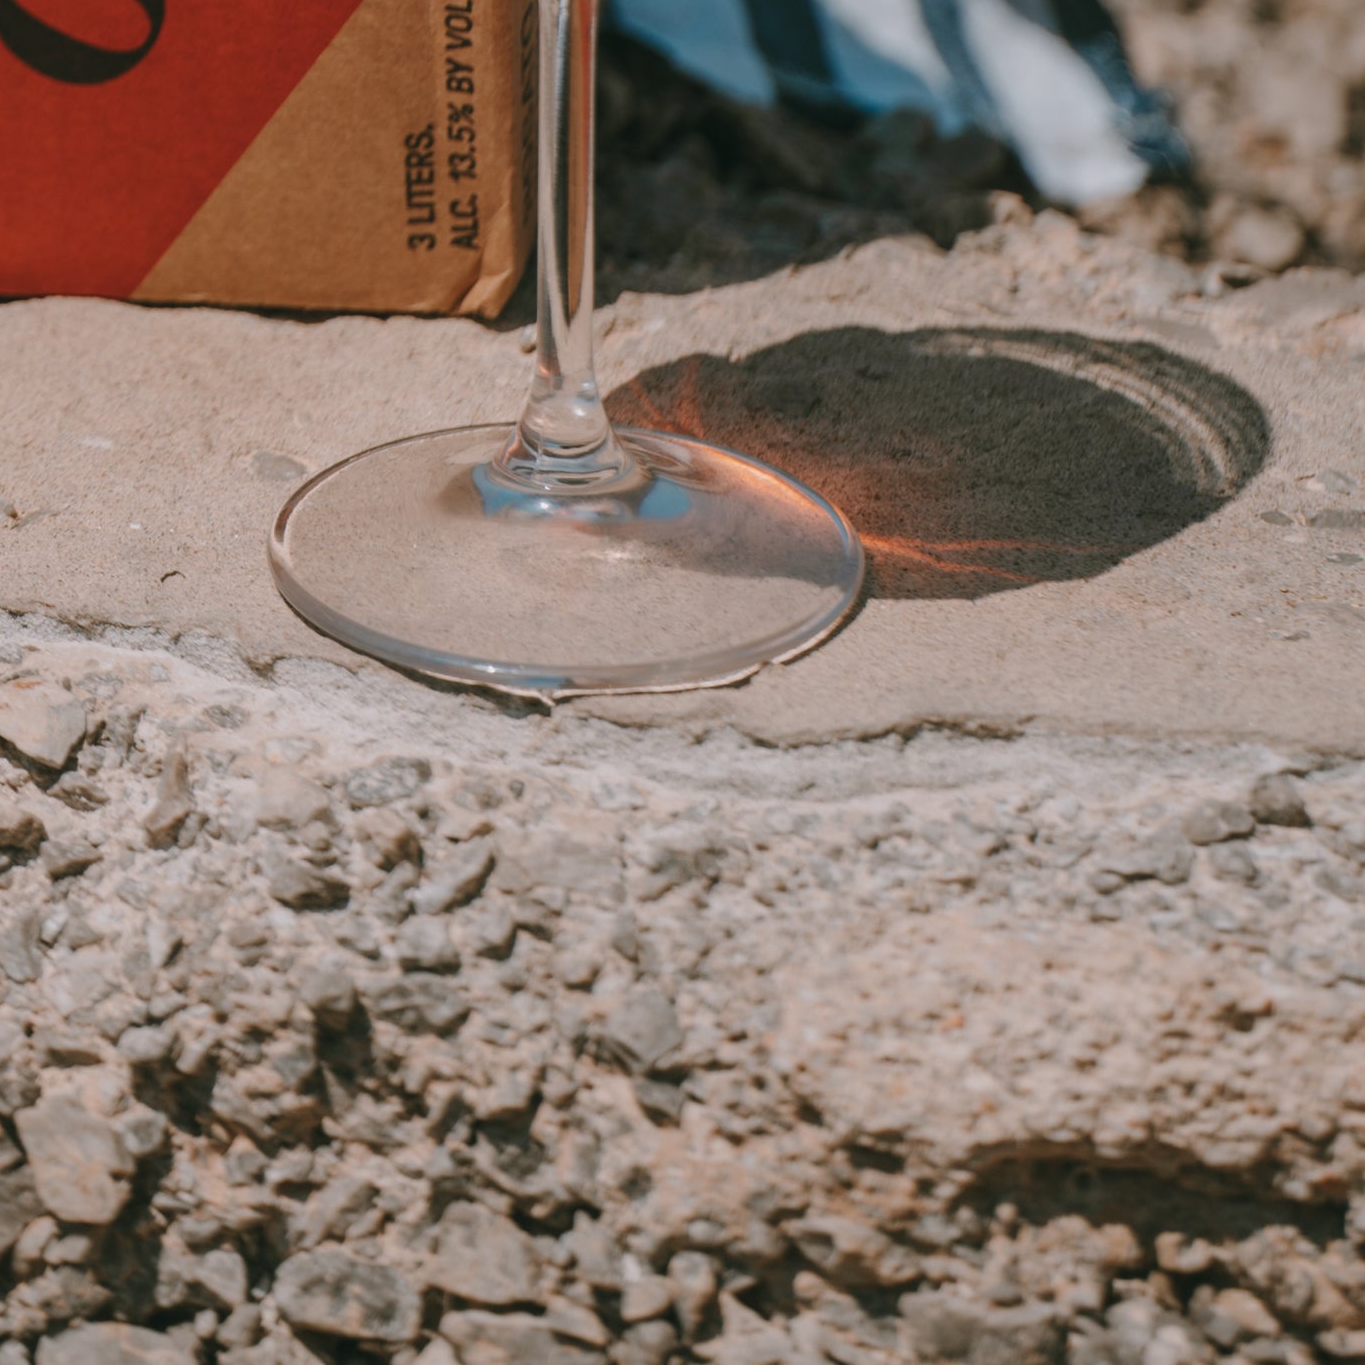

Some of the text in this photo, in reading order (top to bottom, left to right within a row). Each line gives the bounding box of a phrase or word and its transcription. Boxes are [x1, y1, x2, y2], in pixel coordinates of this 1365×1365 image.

[446, 57, 474, 95] BY
[447, 103, 476, 183] 13.5%
[404, 123, 436, 250] 3 LITERS.
[449, 194, 479, 250] ALC.
